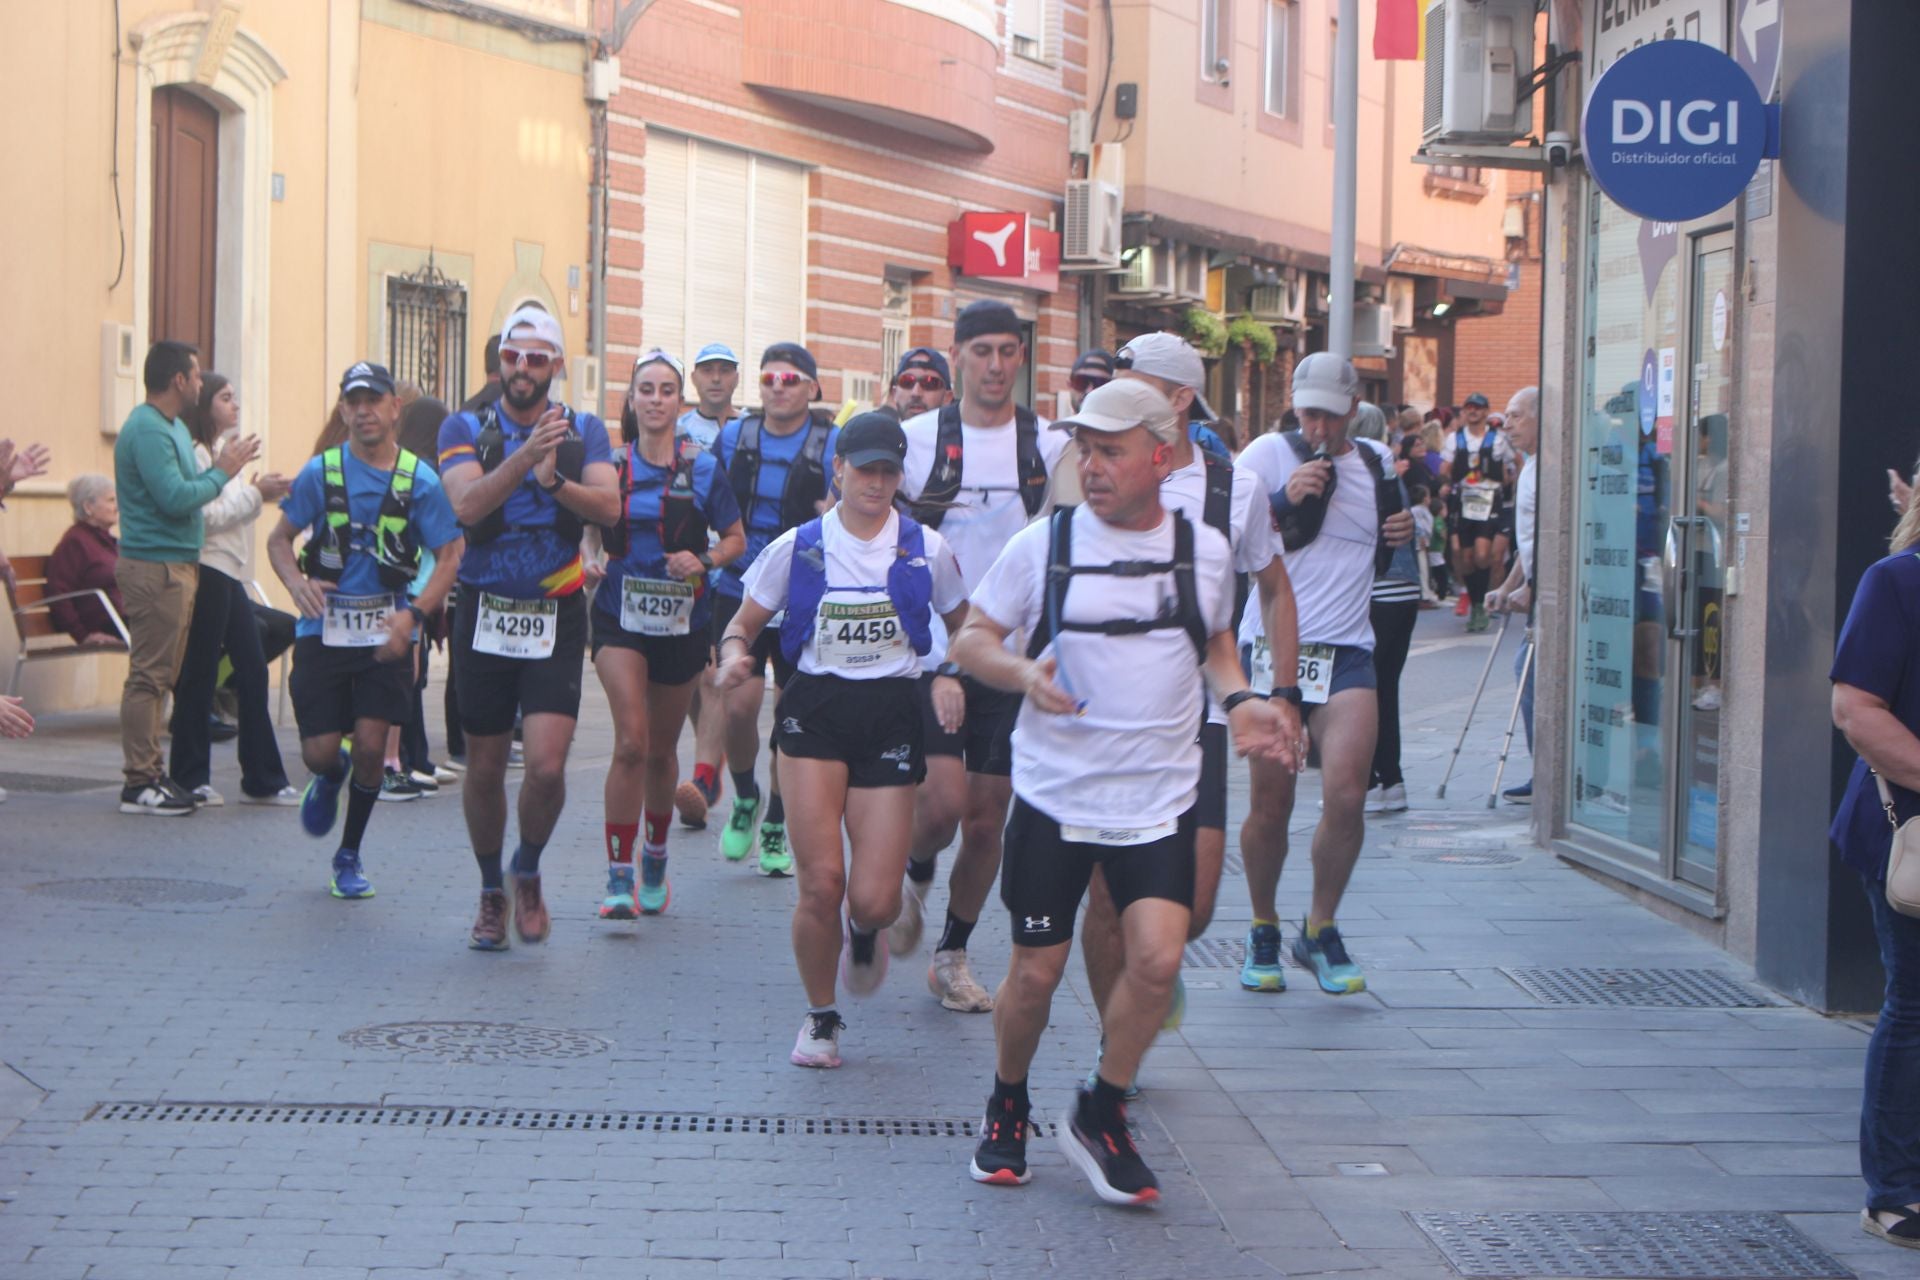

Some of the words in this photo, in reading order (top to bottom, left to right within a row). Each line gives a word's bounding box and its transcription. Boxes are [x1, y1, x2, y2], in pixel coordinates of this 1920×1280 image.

[1612, 99, 1738, 145] DIGI
[1612, 151, 1690, 165] Distribuidor
[1693, 151, 1736, 165] oficial
[637, 596, 684, 617] 4297
[834, 605, 846, 616] LA
[342, 609, 385, 630] 1175
[495, 615, 545, 638] 4299
[837, 620, 896, 645] 4459
